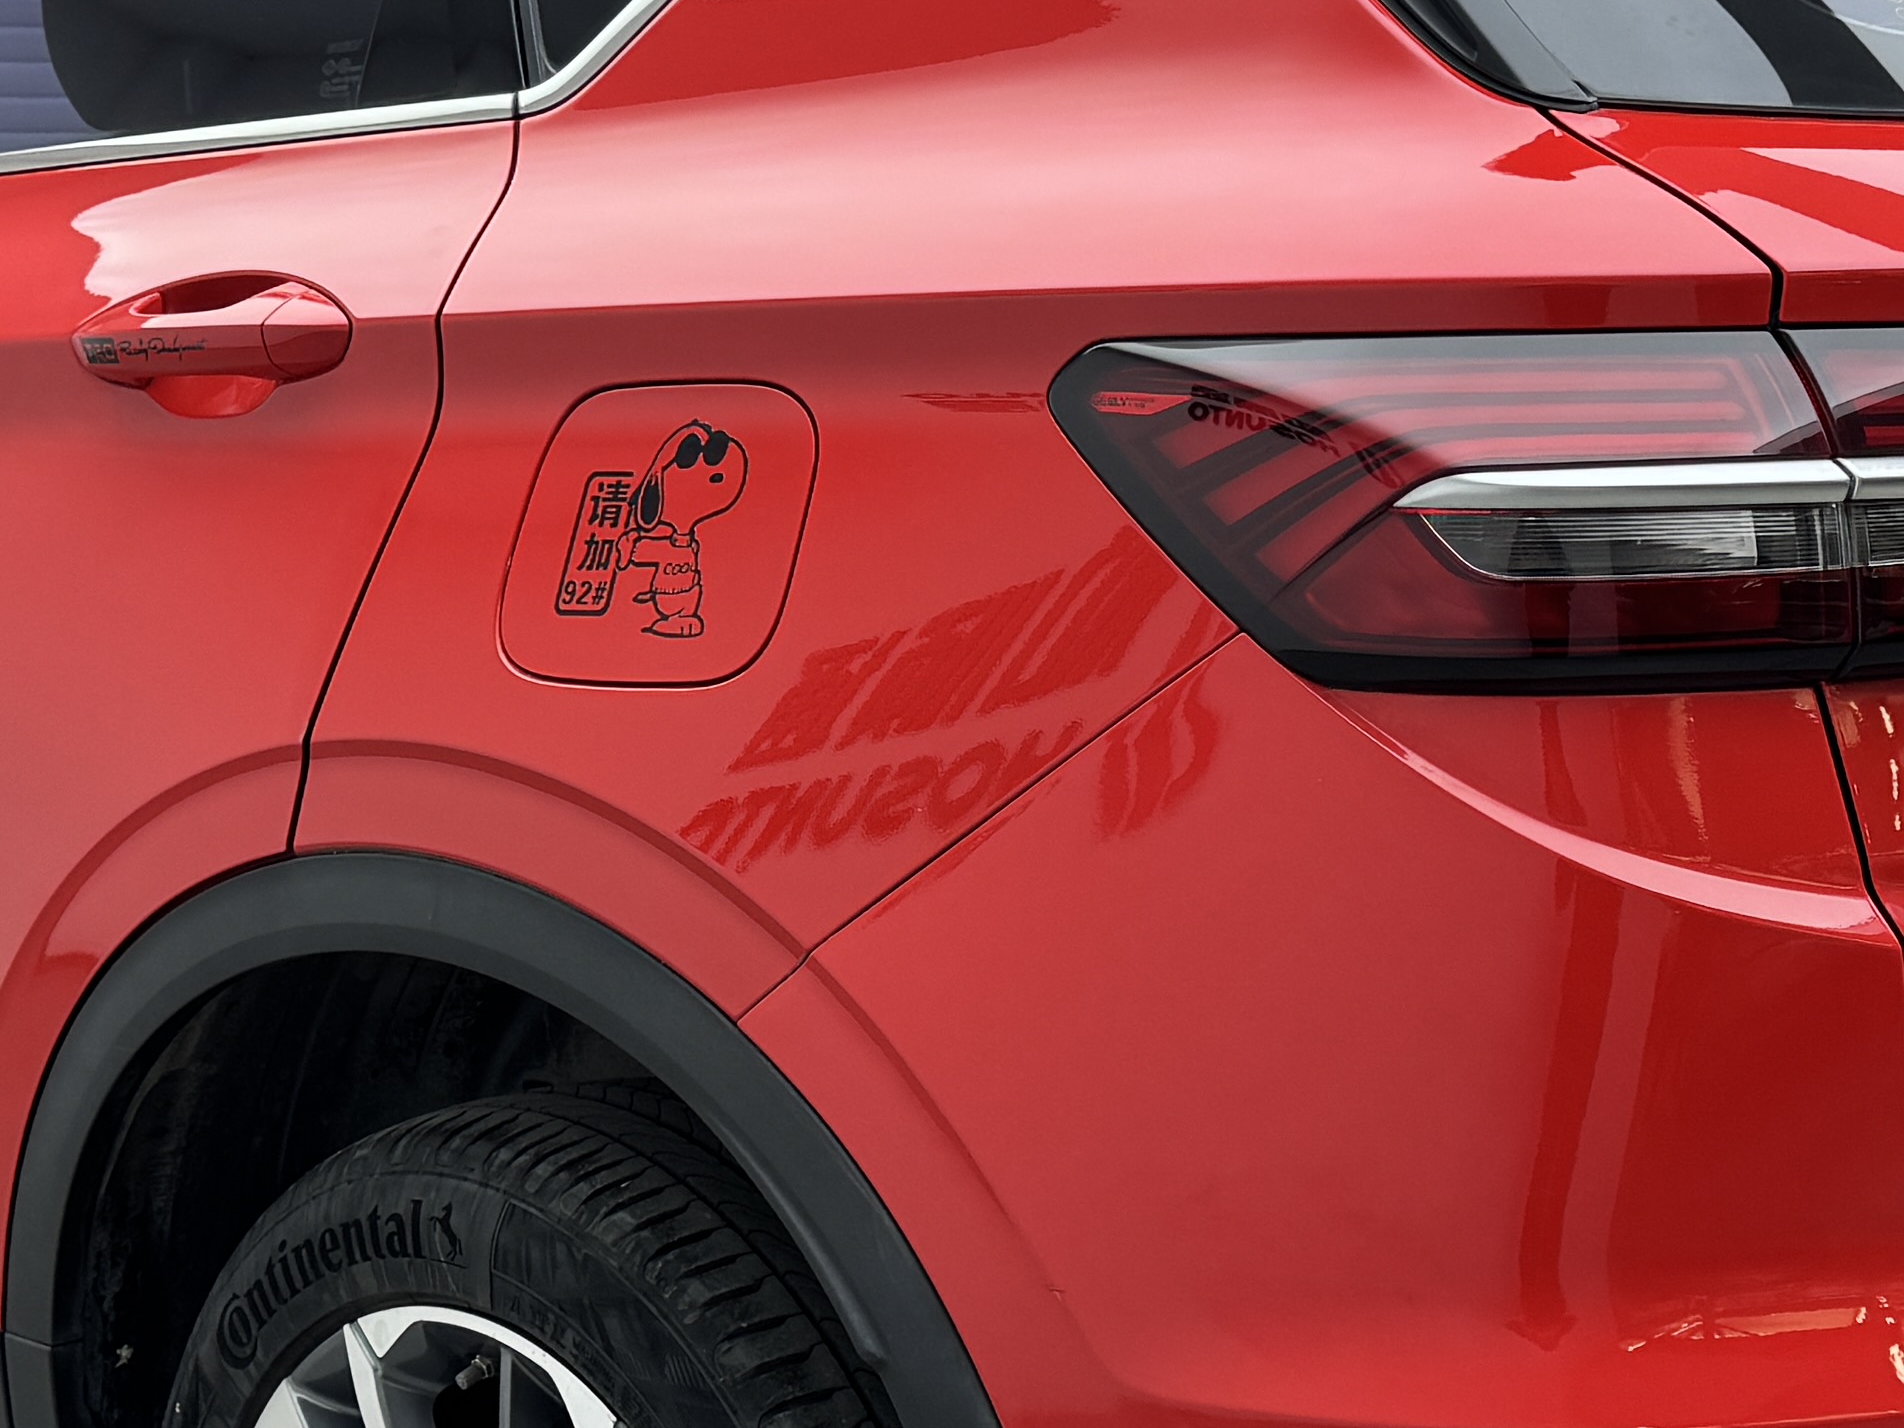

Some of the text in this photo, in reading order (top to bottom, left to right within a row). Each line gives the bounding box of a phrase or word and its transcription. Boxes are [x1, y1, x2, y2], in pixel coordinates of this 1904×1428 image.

[577, 480, 631, 571] 请加
[561, 580, 609, 606] 92#
[216, 1197, 426, 1372] Continental
